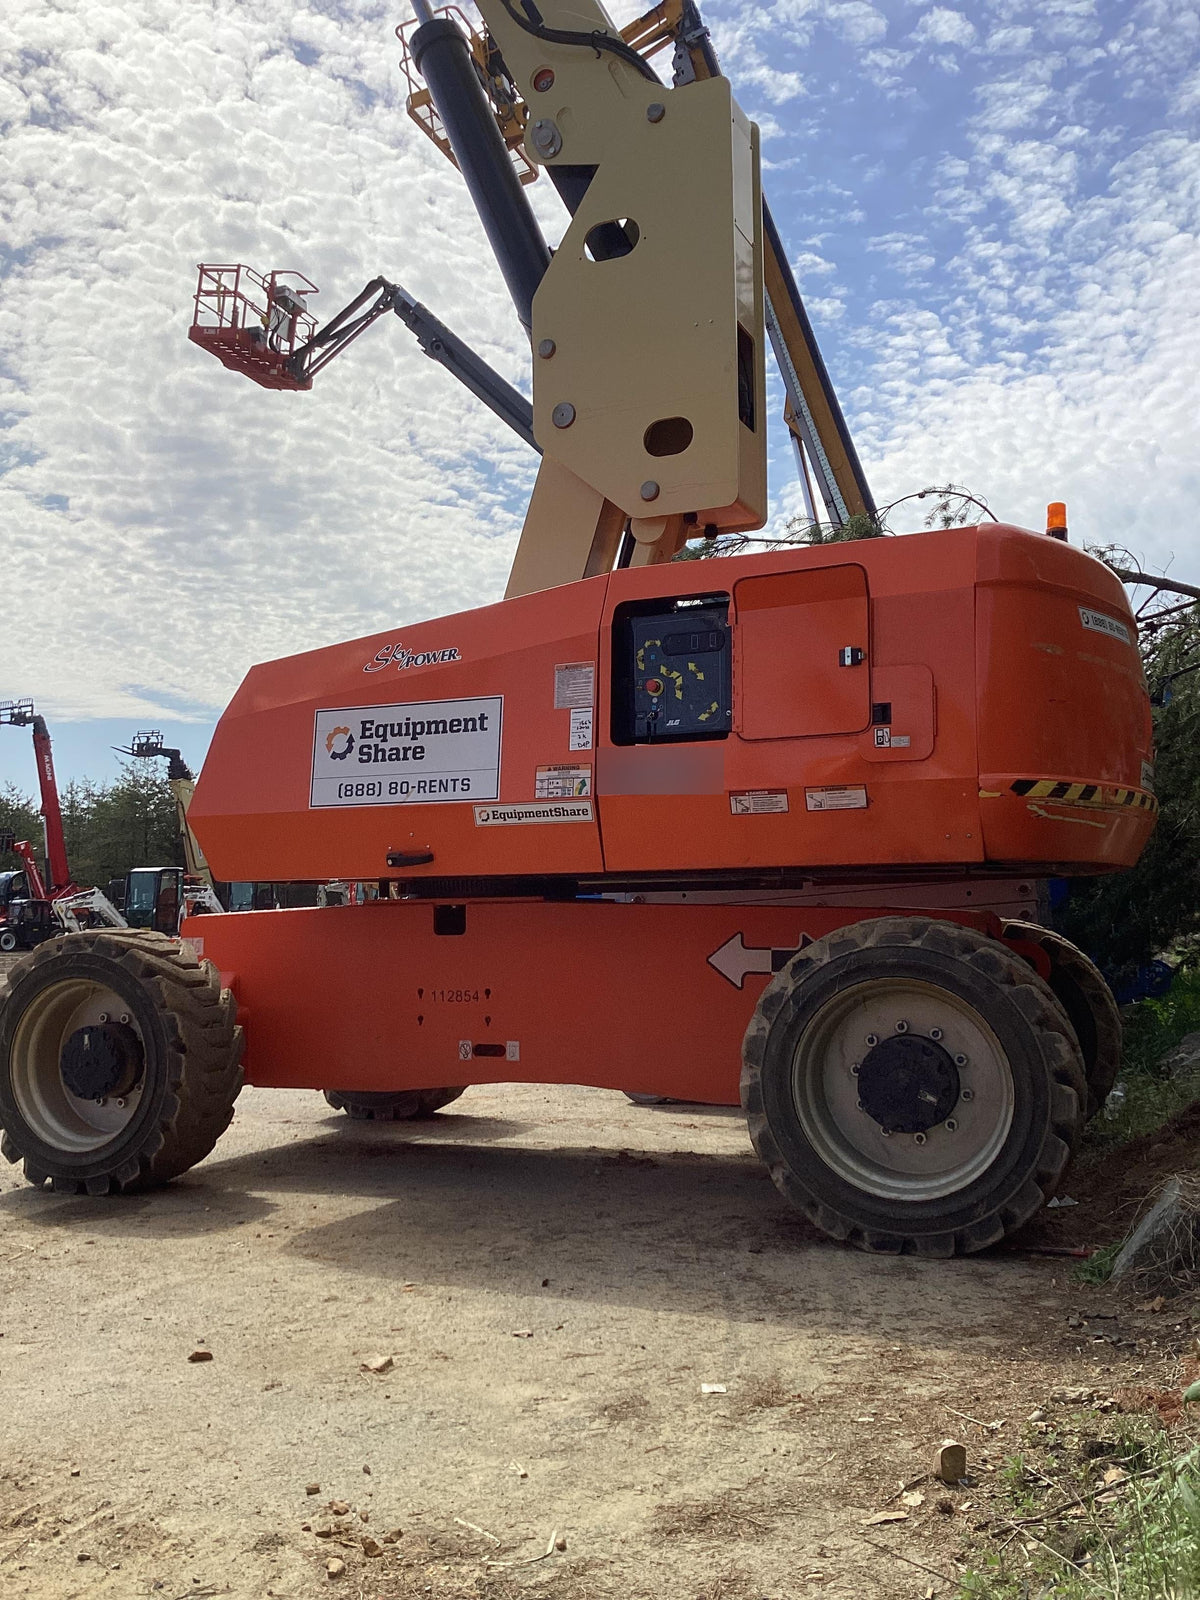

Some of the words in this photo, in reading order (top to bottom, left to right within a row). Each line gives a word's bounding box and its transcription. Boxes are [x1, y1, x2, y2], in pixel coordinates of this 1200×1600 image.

[360, 713, 488, 742] Equipment
[358, 744, 425, 764] Share
[338, 782, 382, 799] (888)
[388, 778, 471, 795] 80-RENTS
[492, 807, 589, 821] EquipmentShare
[431, 990, 479, 1003] 112854
